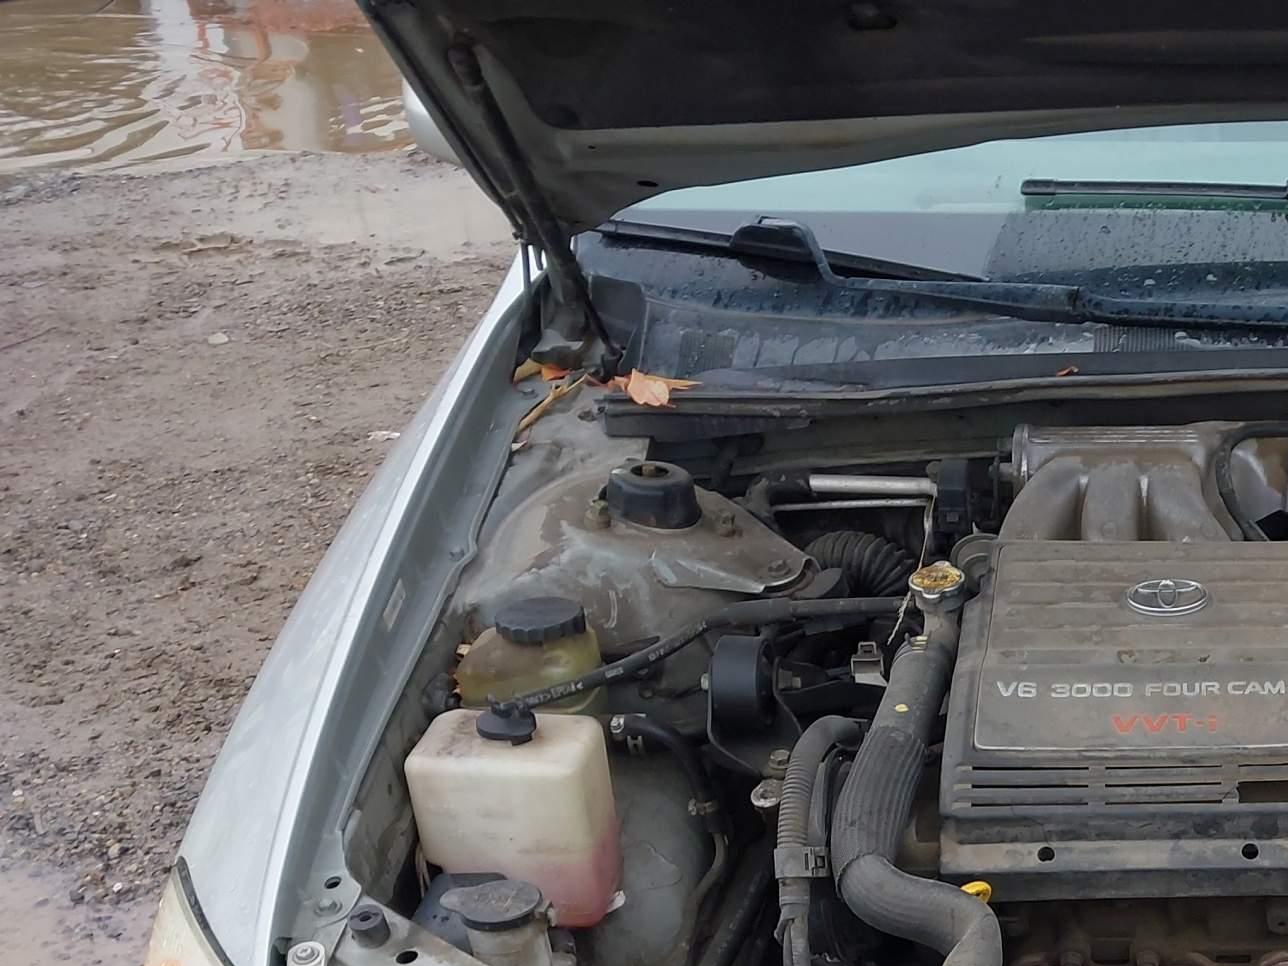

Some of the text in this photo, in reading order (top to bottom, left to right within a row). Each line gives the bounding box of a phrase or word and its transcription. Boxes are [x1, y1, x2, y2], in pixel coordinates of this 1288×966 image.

[996, 680, 1037, 697] V6
[1050, 682, 1133, 698] 3000
[1145, 681, 1221, 697] FOUR
[1228, 679, 1286, 695] CAM
[1111, 713, 1219, 734] VVT-i
